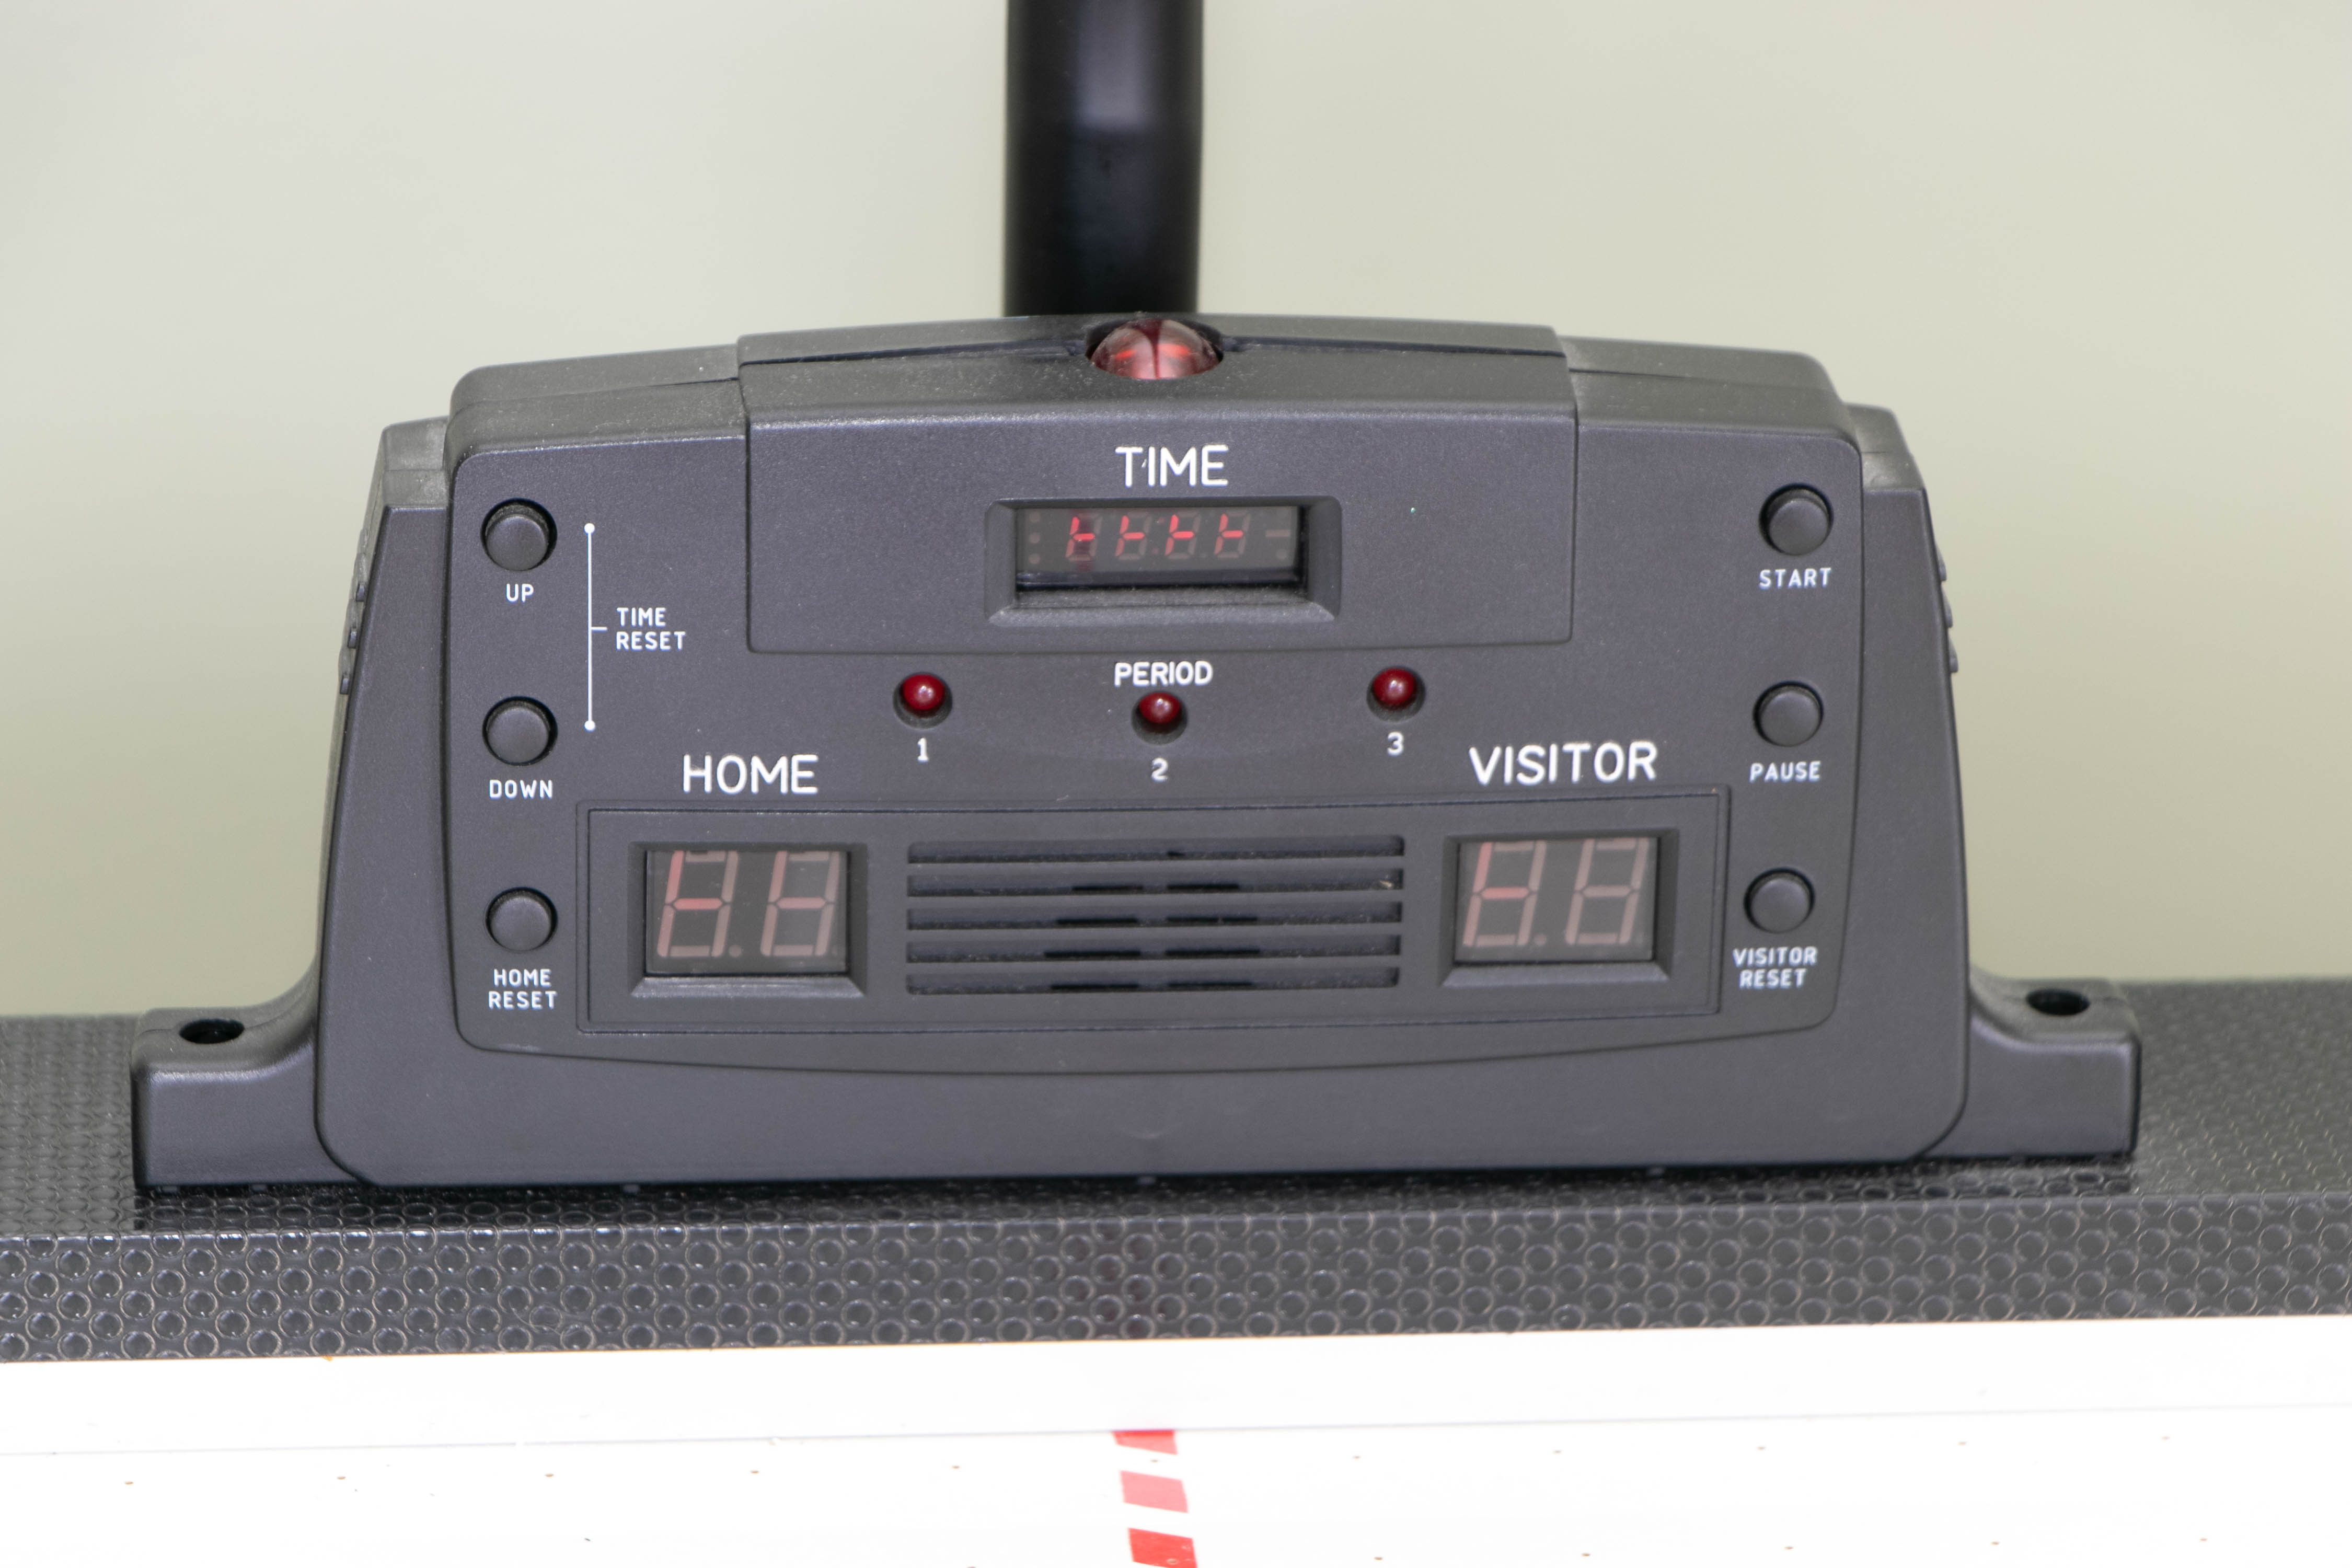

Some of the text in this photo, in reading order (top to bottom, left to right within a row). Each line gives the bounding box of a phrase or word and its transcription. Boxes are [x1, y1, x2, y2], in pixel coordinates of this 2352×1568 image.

[1114, 443, 1229, 488] TIME
[1759, 567, 1832, 590] START
[505, 582, 535, 603] UP
[616, 606, 667, 628] TIME
[615, 630, 687, 651] RESET
[1113, 660, 1214, 688] PERIOD
[917, 737, 929, 763] 1
[1387, 731, 1404, 756] 3
[1151, 756, 1169, 782] 2
[1468, 739, 1658, 786] VISITOR
[1749, 760, 1821, 782] PAUSE
[683, 753, 820, 795] HOME
[489, 779, 554, 800] DOWN
[1732, 946, 1818, 967] VISITOR
[493, 968, 552, 988] HOME
[1739, 967, 1807, 989] RESET
[488, 990, 558, 1010] RESET
